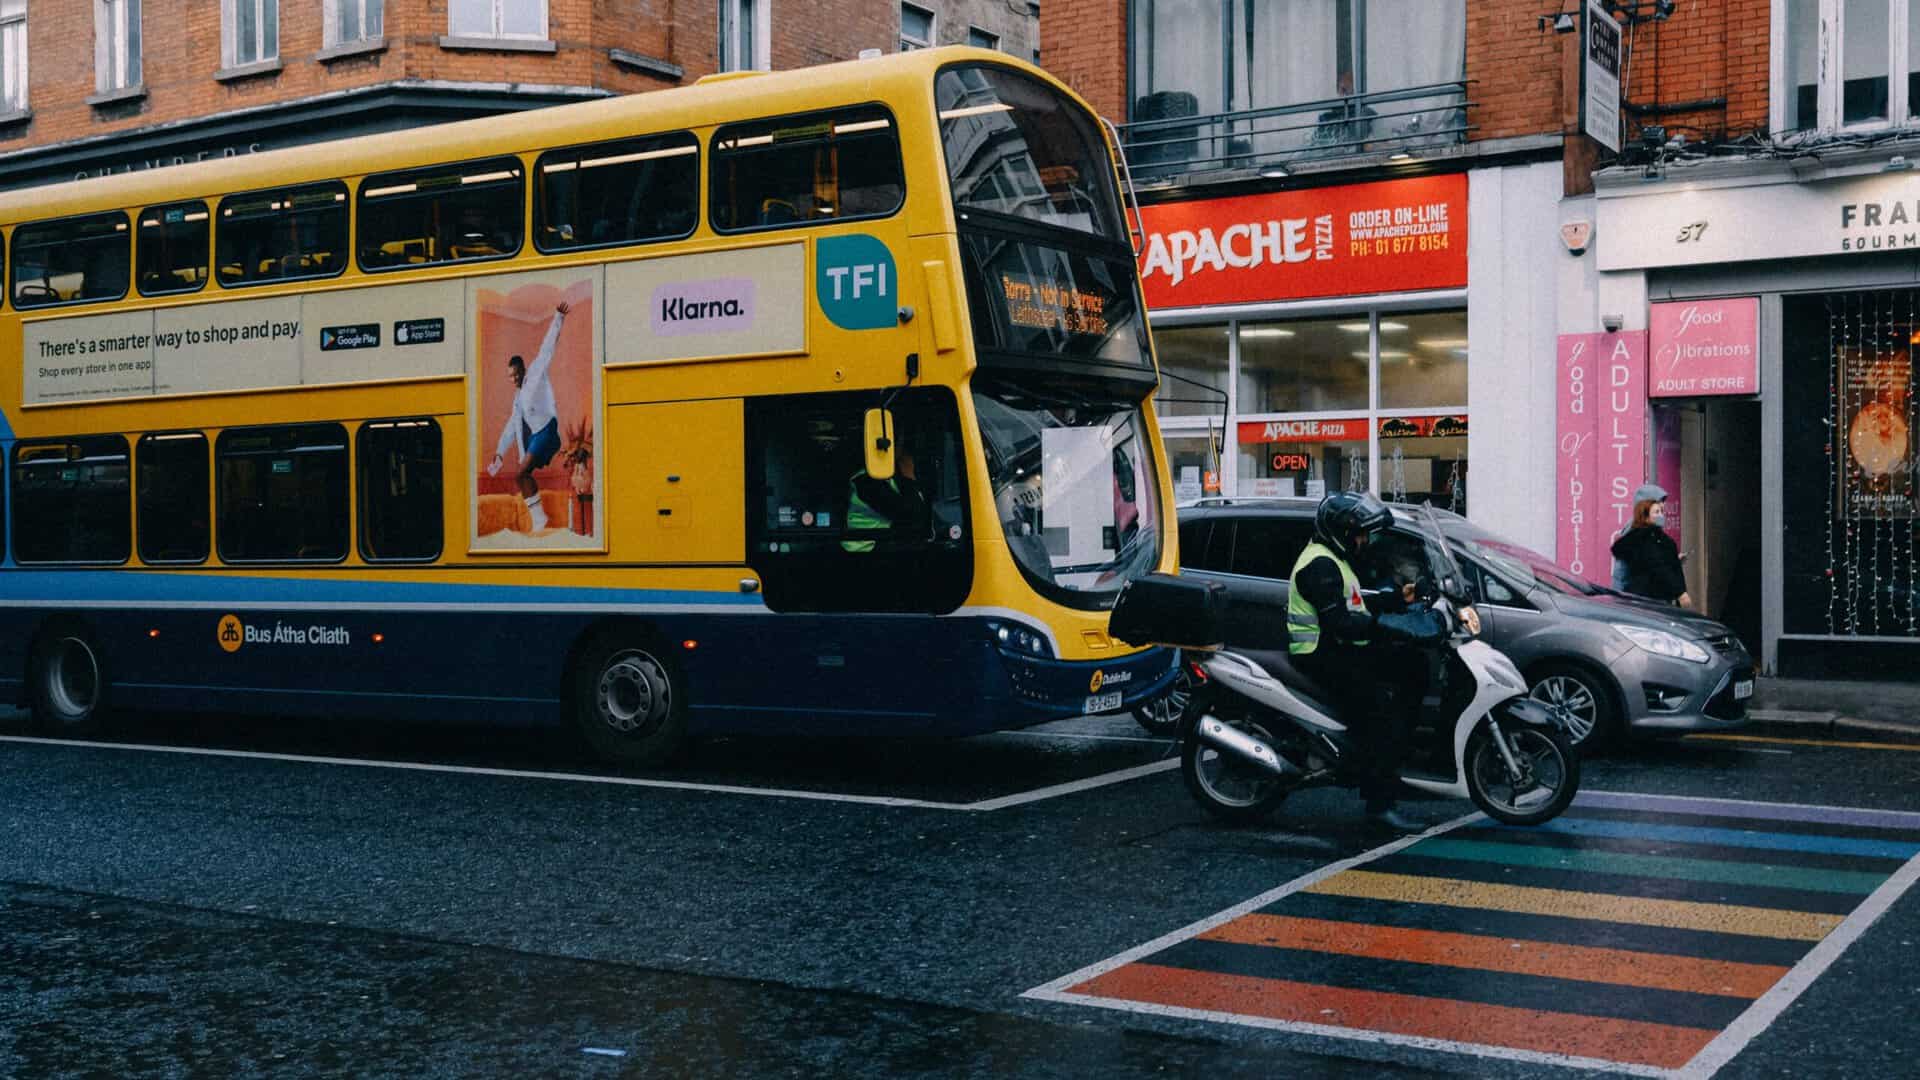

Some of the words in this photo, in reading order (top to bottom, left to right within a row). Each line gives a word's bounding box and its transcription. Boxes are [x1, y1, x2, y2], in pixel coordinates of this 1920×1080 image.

[1349, 208, 1391, 229] ORDER
[1394, 203, 1448, 225] ON-LINE
[1350, 221, 1448, 241] WWW.APACHEPIZZA.COM
[1676, 221, 1708, 243] 57
[1842, 233, 1916, 250] GOURM
[1141, 217, 1312, 286] APACHE
[1315, 214, 1333, 260] PIZZA
[1351, 240, 1371, 257] PH:
[1376, 239, 1389, 255] 01
[1393, 236, 1415, 254] 677
[1419, 233, 1448, 252] 8154
[826, 263, 886, 300] TFI
[662, 298, 744, 322] Klarna.
[39, 339, 87, 357] There's
[89, 341, 96, 353] a
[99, 335, 151, 352] smarter
[155, 331, 182, 349] way
[186, 329, 200, 344] to
[203, 325, 238, 344] shop
[242, 321, 269, 340] and
[272, 320, 301, 340] pay.
[337, 335, 362, 347] Google
[362, 333, 377, 345] Play
[410, 331, 424, 341] App
[425, 329, 441, 339] Store
[39, 365, 60, 378] Shop
[61, 364, 83, 377] every
[86, 362, 106, 374] store
[108, 361, 116, 372] in
[118, 361, 133, 372] one
[1656, 379, 1697, 392] ADULT
[1702, 376, 1745, 390] STORE
[1611, 339, 1630, 465] ADULT
[1264, 421, 1320, 440] APACHE
[1322, 423, 1344, 436] PIZZA
[1272, 455, 1308, 470] OPEN
[245, 625, 271, 644] Bus
[273, 620, 306, 644] Átha
[308, 625, 350, 645] Cliath
